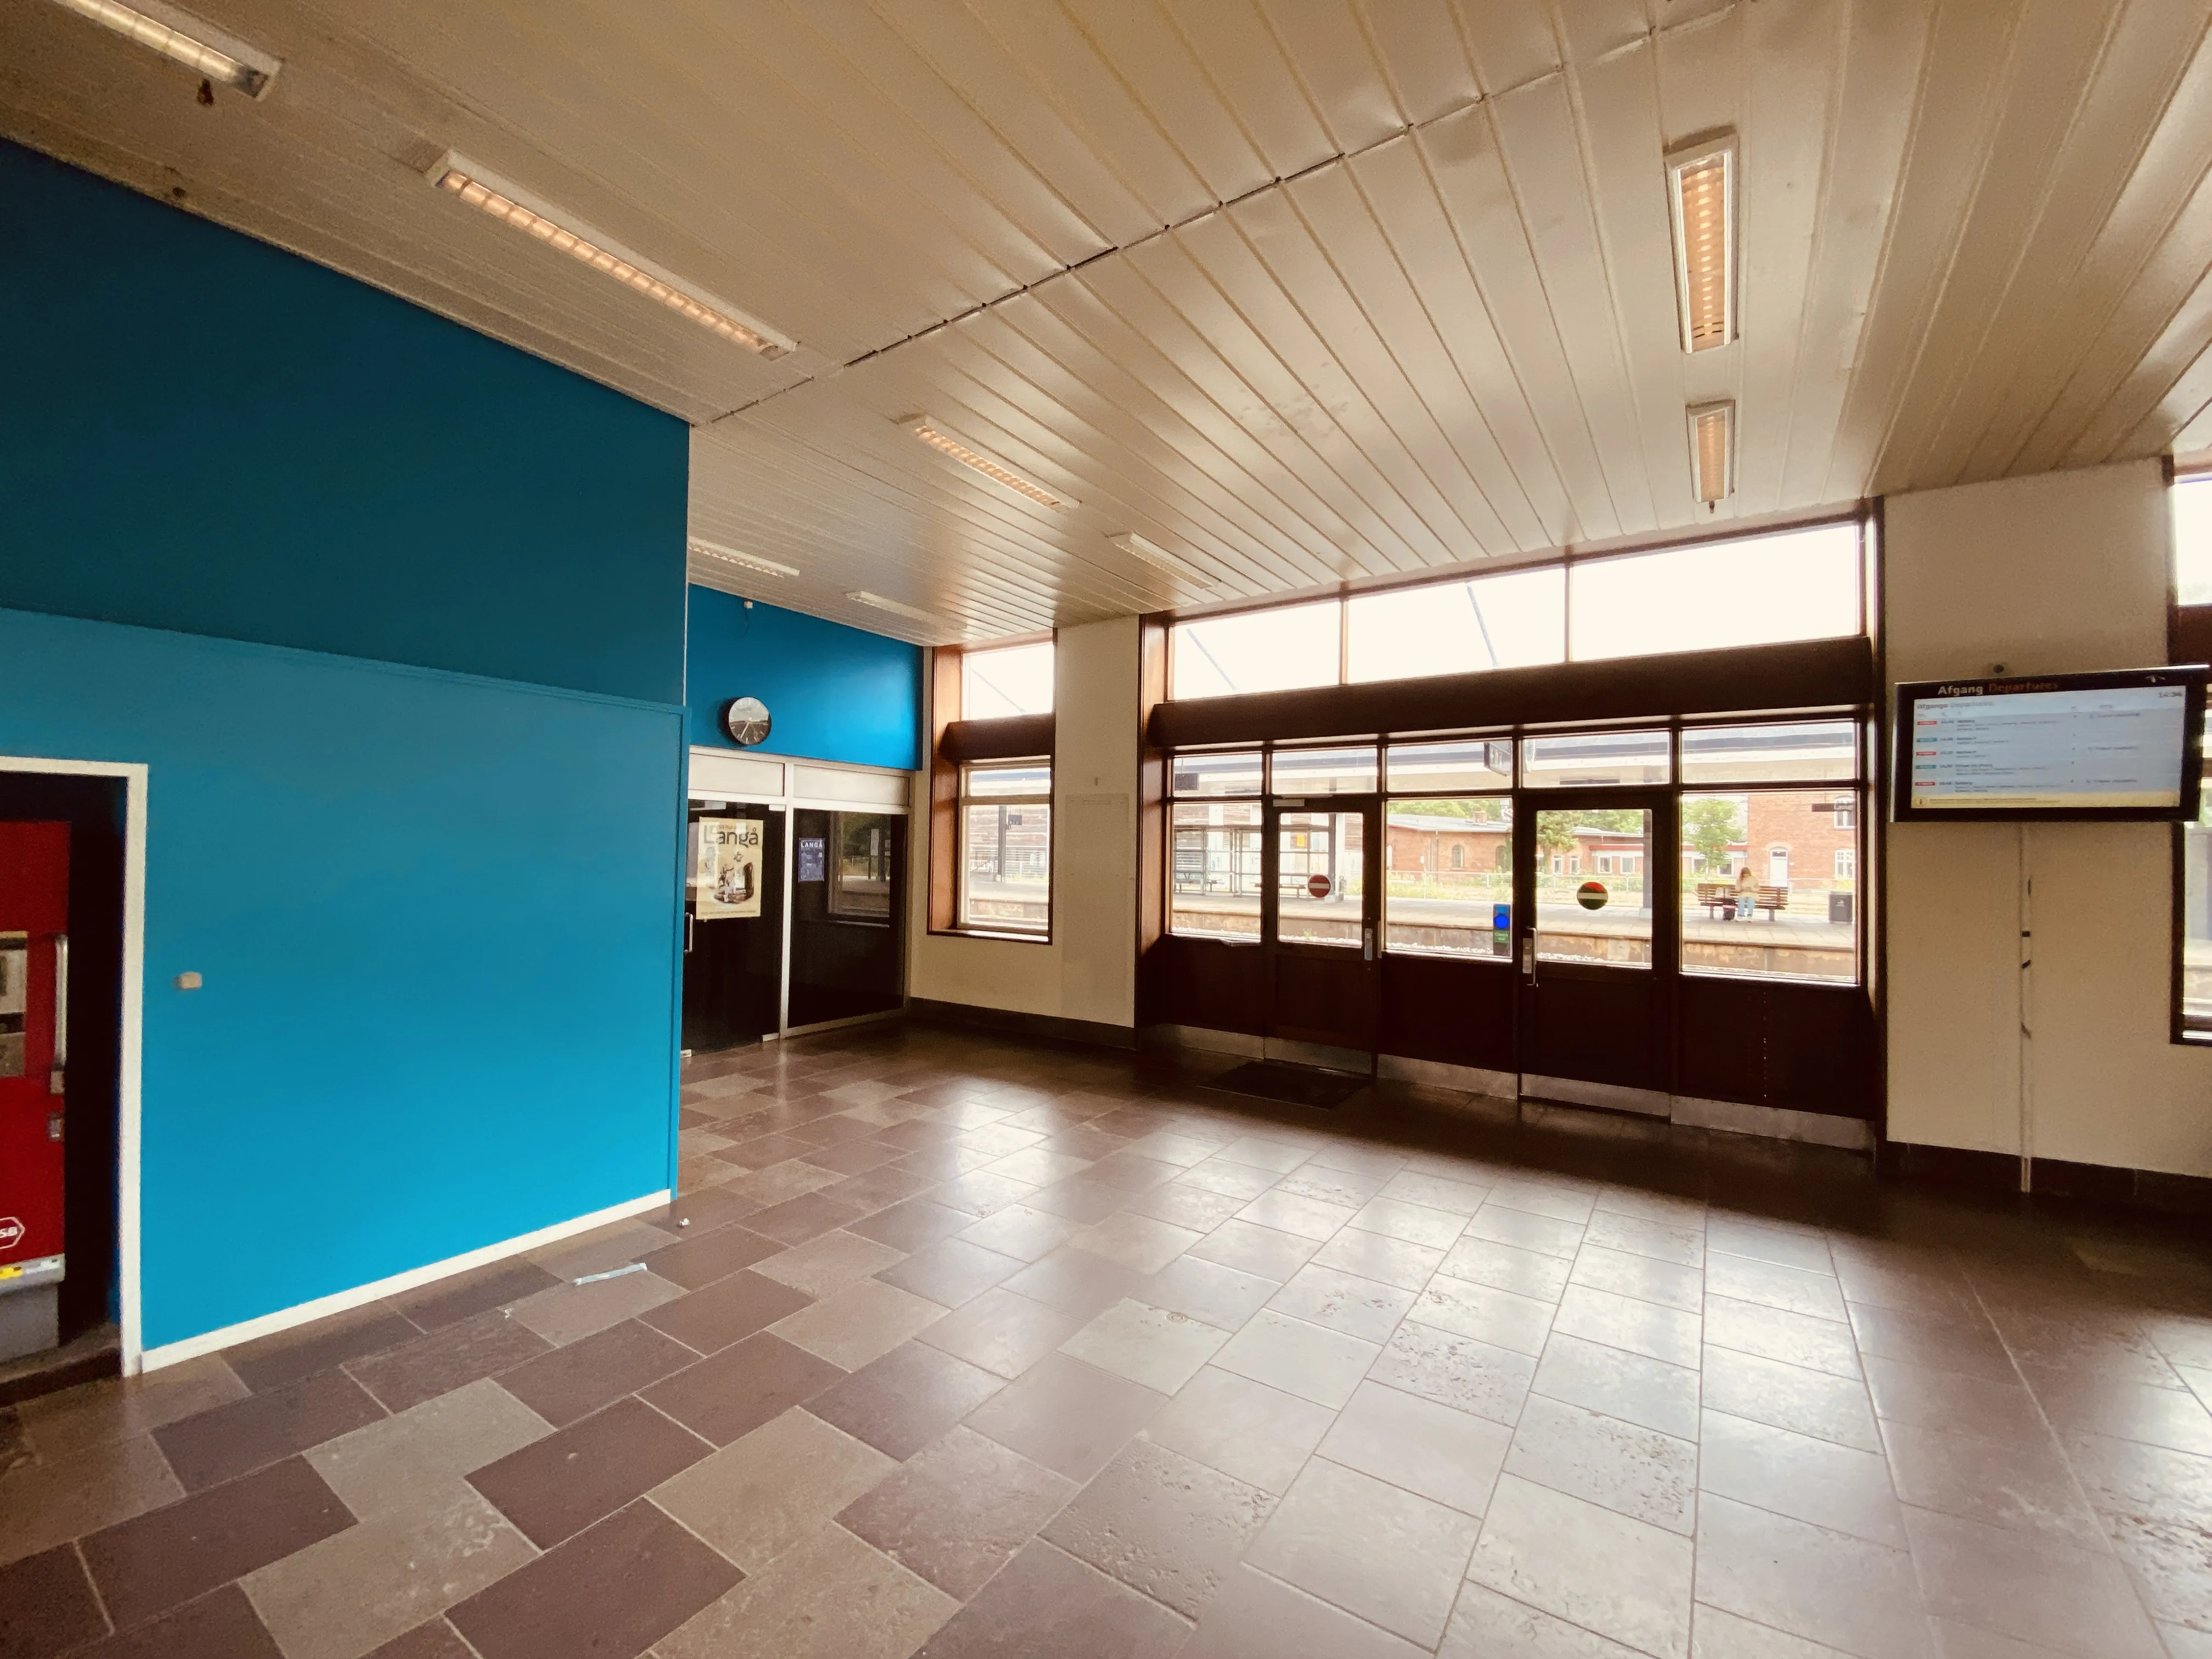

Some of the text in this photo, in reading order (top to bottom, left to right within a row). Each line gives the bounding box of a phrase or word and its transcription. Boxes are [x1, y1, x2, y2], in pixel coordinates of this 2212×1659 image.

[1938, 685, 1984, 697] Afgang
[703, 825, 759, 848] Langå
[801, 840, 823, 848] LANGÅ
[0, 1226, 18, 1238] SB
